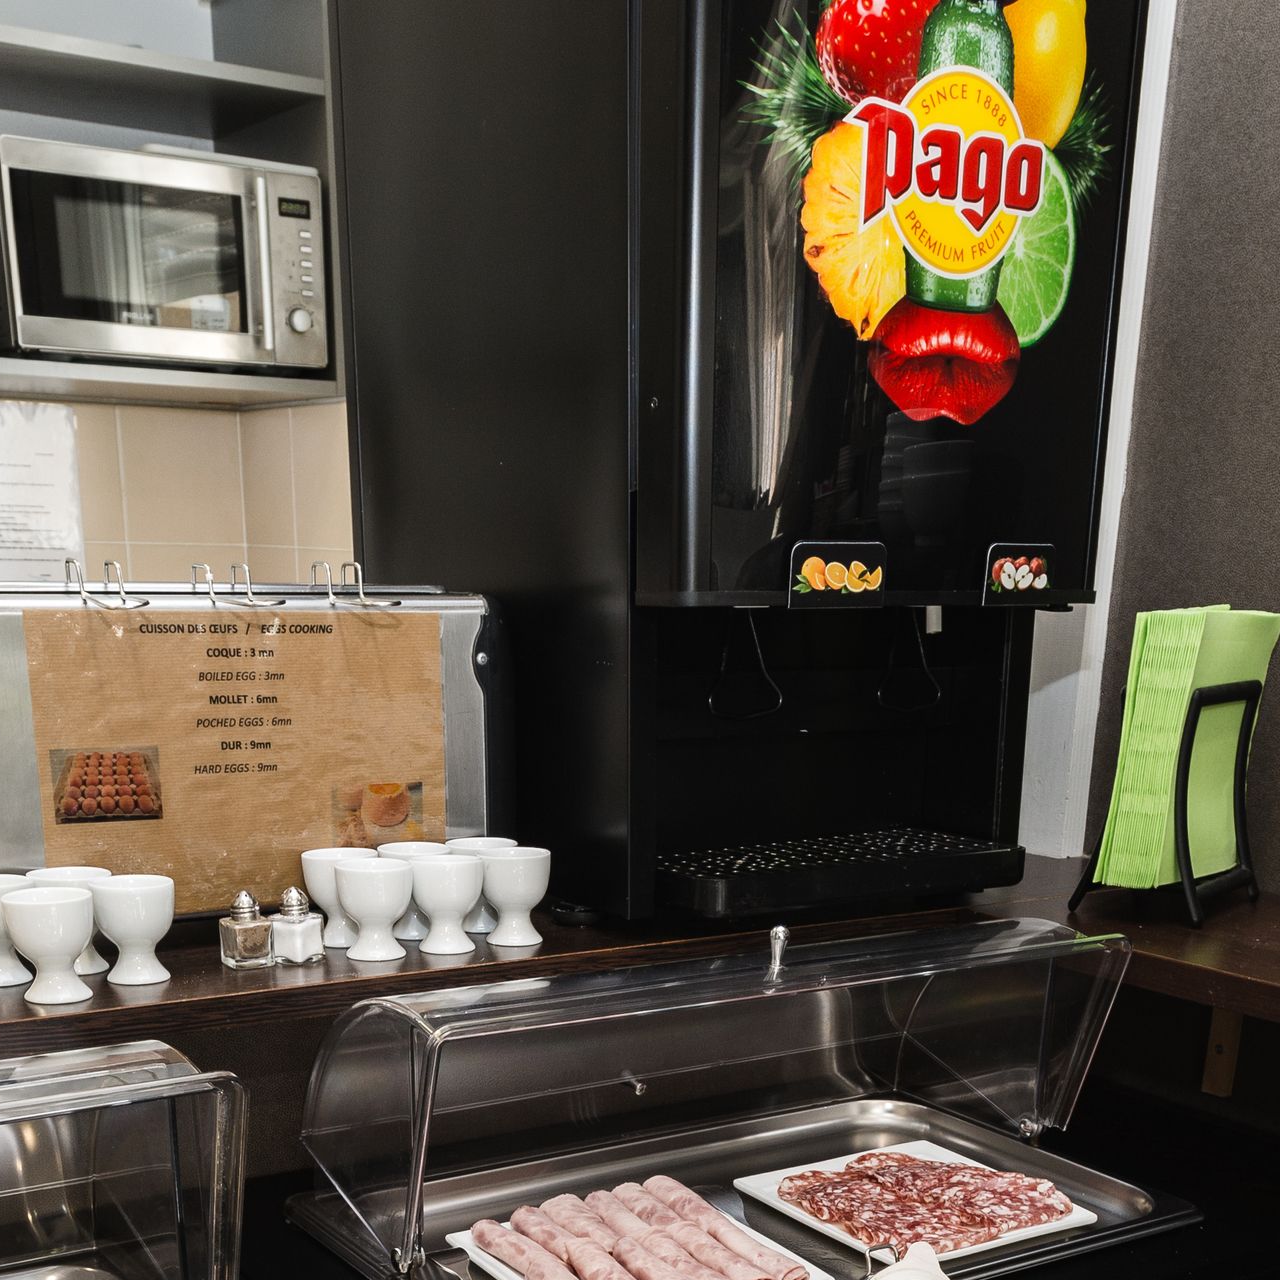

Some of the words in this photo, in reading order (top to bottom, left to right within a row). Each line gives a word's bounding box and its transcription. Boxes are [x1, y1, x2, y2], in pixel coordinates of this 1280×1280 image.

[920, 83, 969, 116] SINCE
[975, 88, 1008, 128] 1888
[905, 209, 966, 264] PREMIUM
[969, 219, 1008, 261] FRUIT
[139, 623, 185, 634] CUISSON
[209, 623, 238, 634] ŒUFS
[289, 624, 333, 634] COOKING
[206, 648, 242, 658] COQUE
[198, 671, 234, 682] BOILED
[235, 671, 256, 681] EGG
[209, 695, 248, 705] MOLLET
[196, 718, 236, 728] POCHED
[238, 717, 264, 727] EGGS
[221, 741, 243, 751] DUR
[249, 741, 271, 750] 9mn
[194, 764, 222, 775] HARD
[224, 764, 250, 774] EGGS
